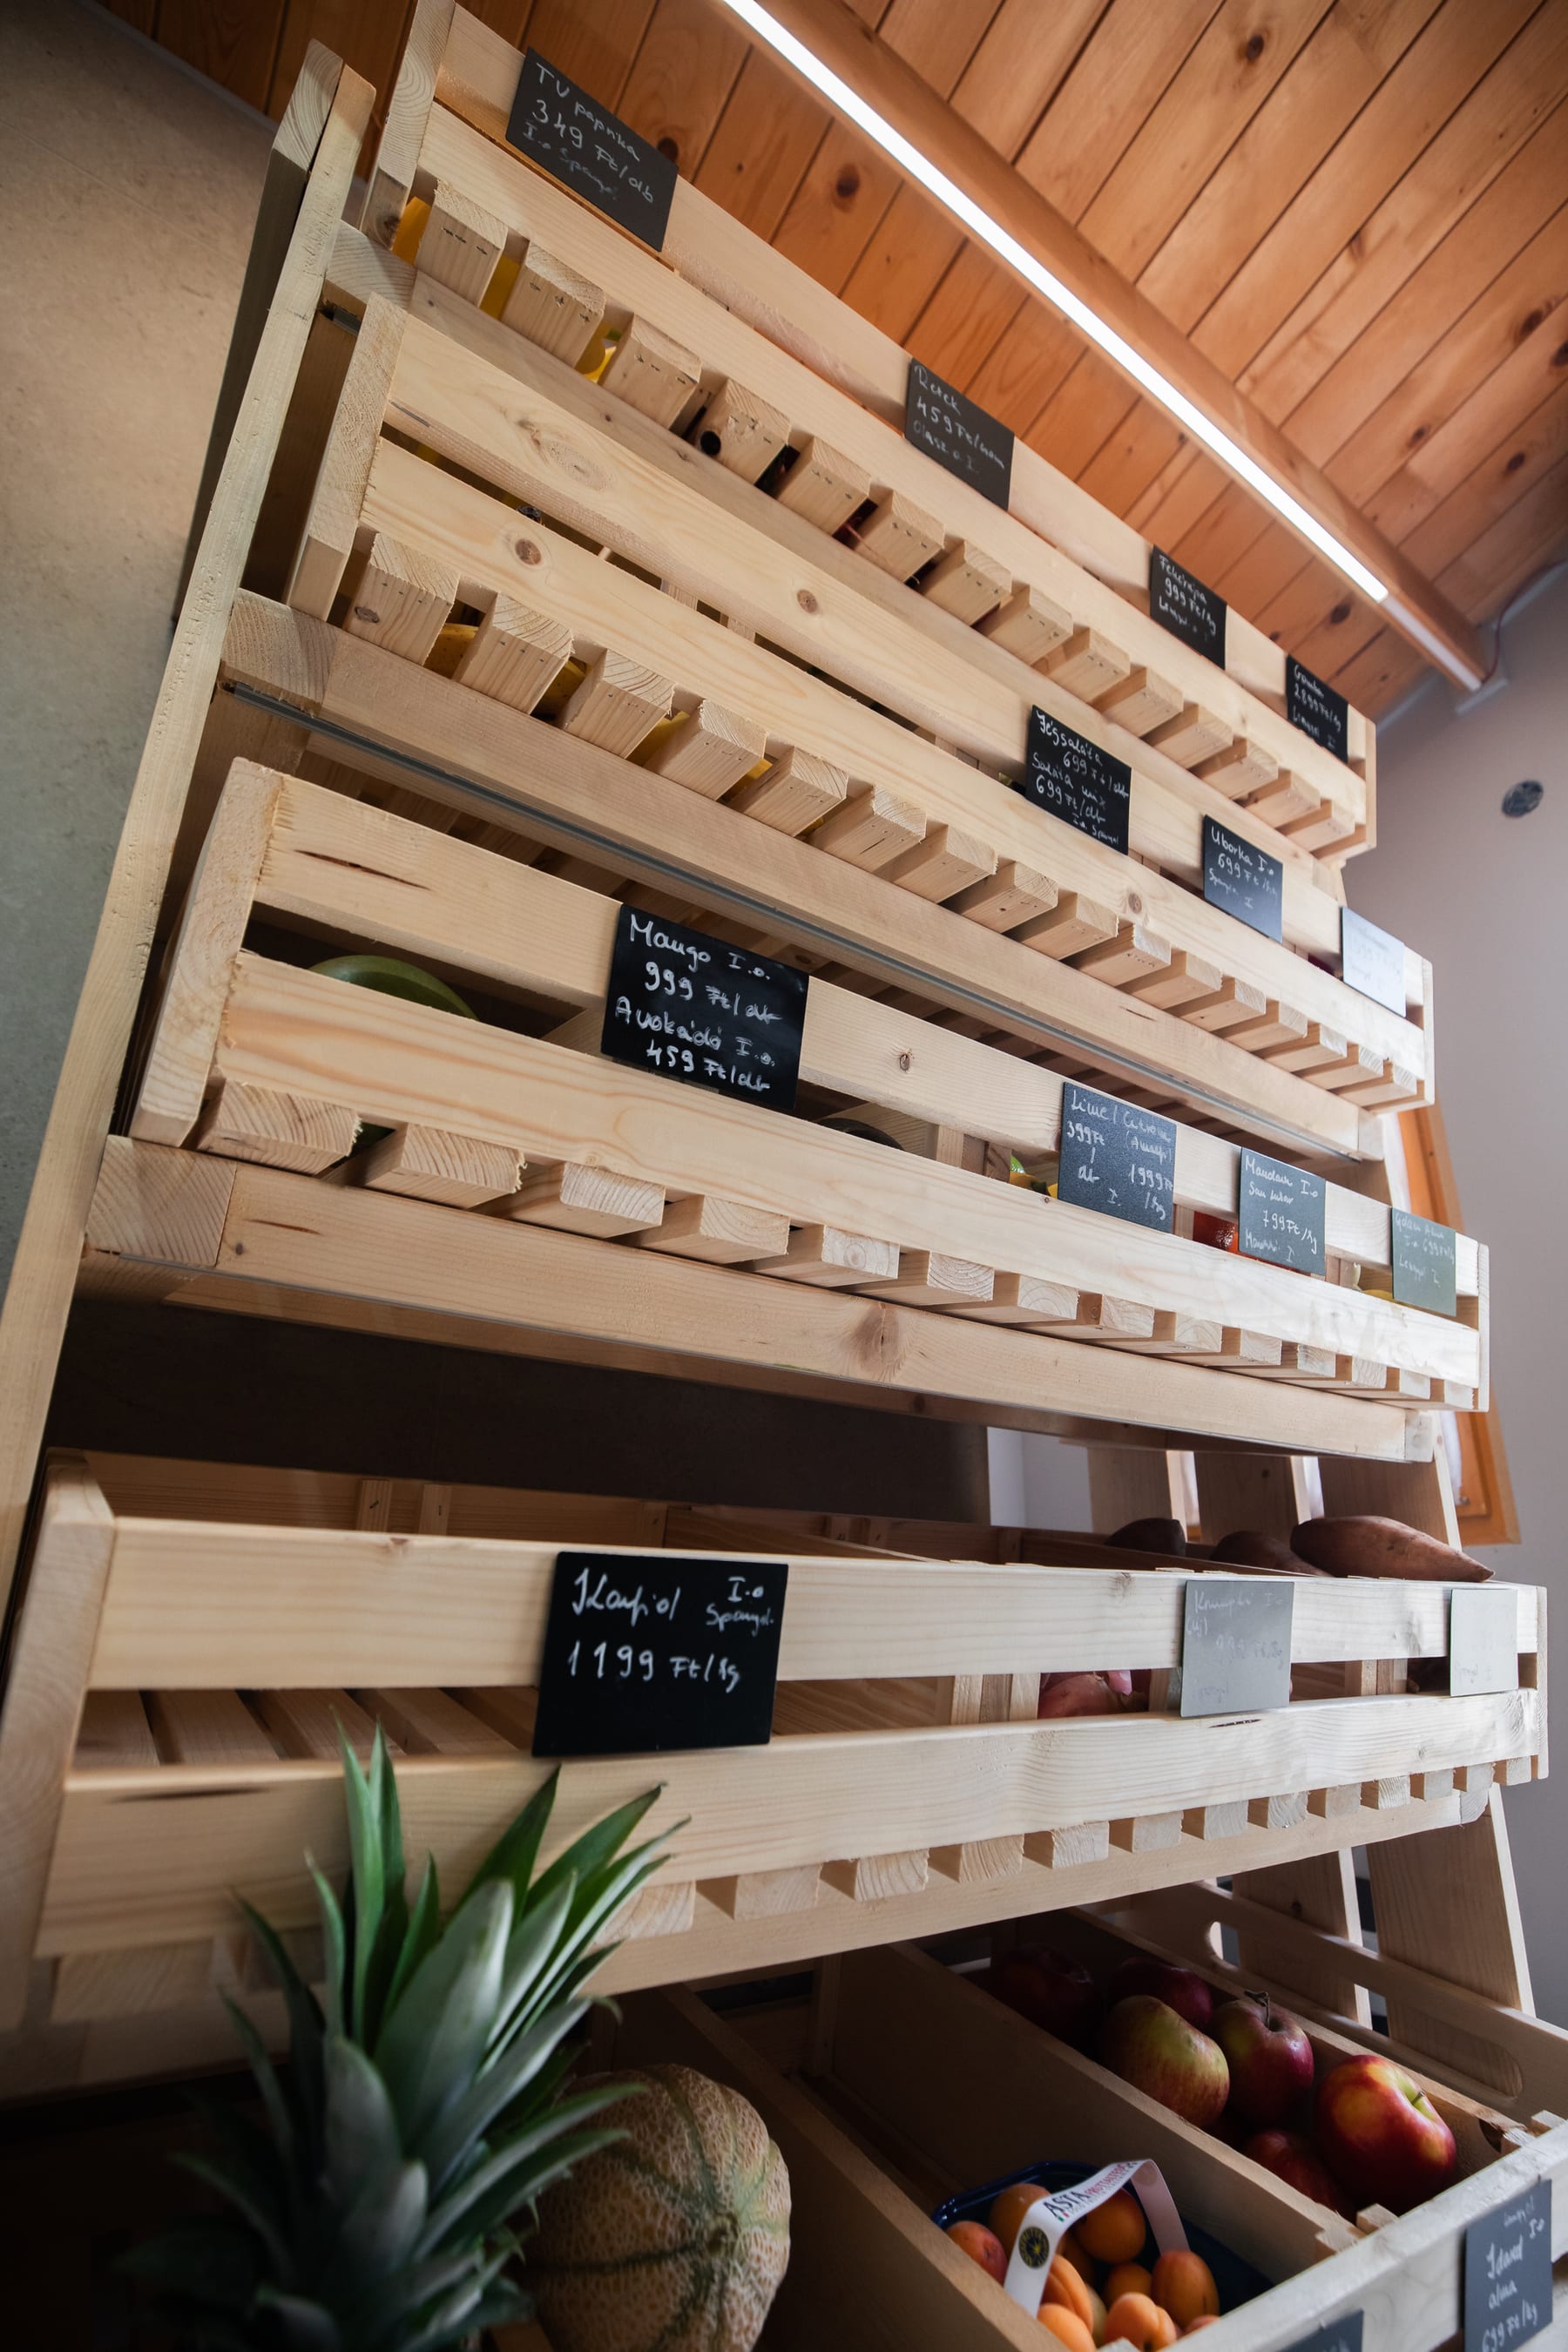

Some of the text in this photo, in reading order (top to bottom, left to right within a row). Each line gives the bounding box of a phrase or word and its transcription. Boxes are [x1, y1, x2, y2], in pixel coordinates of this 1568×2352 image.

[531, 98, 584, 149] 349
[916, 395, 953, 434] 459
[1165, 577, 1186, 607] 999
[1063, 750, 1088, 776] 699
[1036, 774, 1063, 806] 699
[1211, 825, 1254, 868] Uborka
[1218, 852, 1241, 880] 699
[629, 913, 713, 973] Mango
[644, 960, 695, 1002] 999
[614, 995, 724, 1051] Avokádó
[645, 1038, 696, 1073] 459
[571, 1566, 682, 1628] Karfiol
[567, 1639, 655, 1683] 1199
[1042, 2190, 1091, 2223] ASTA
